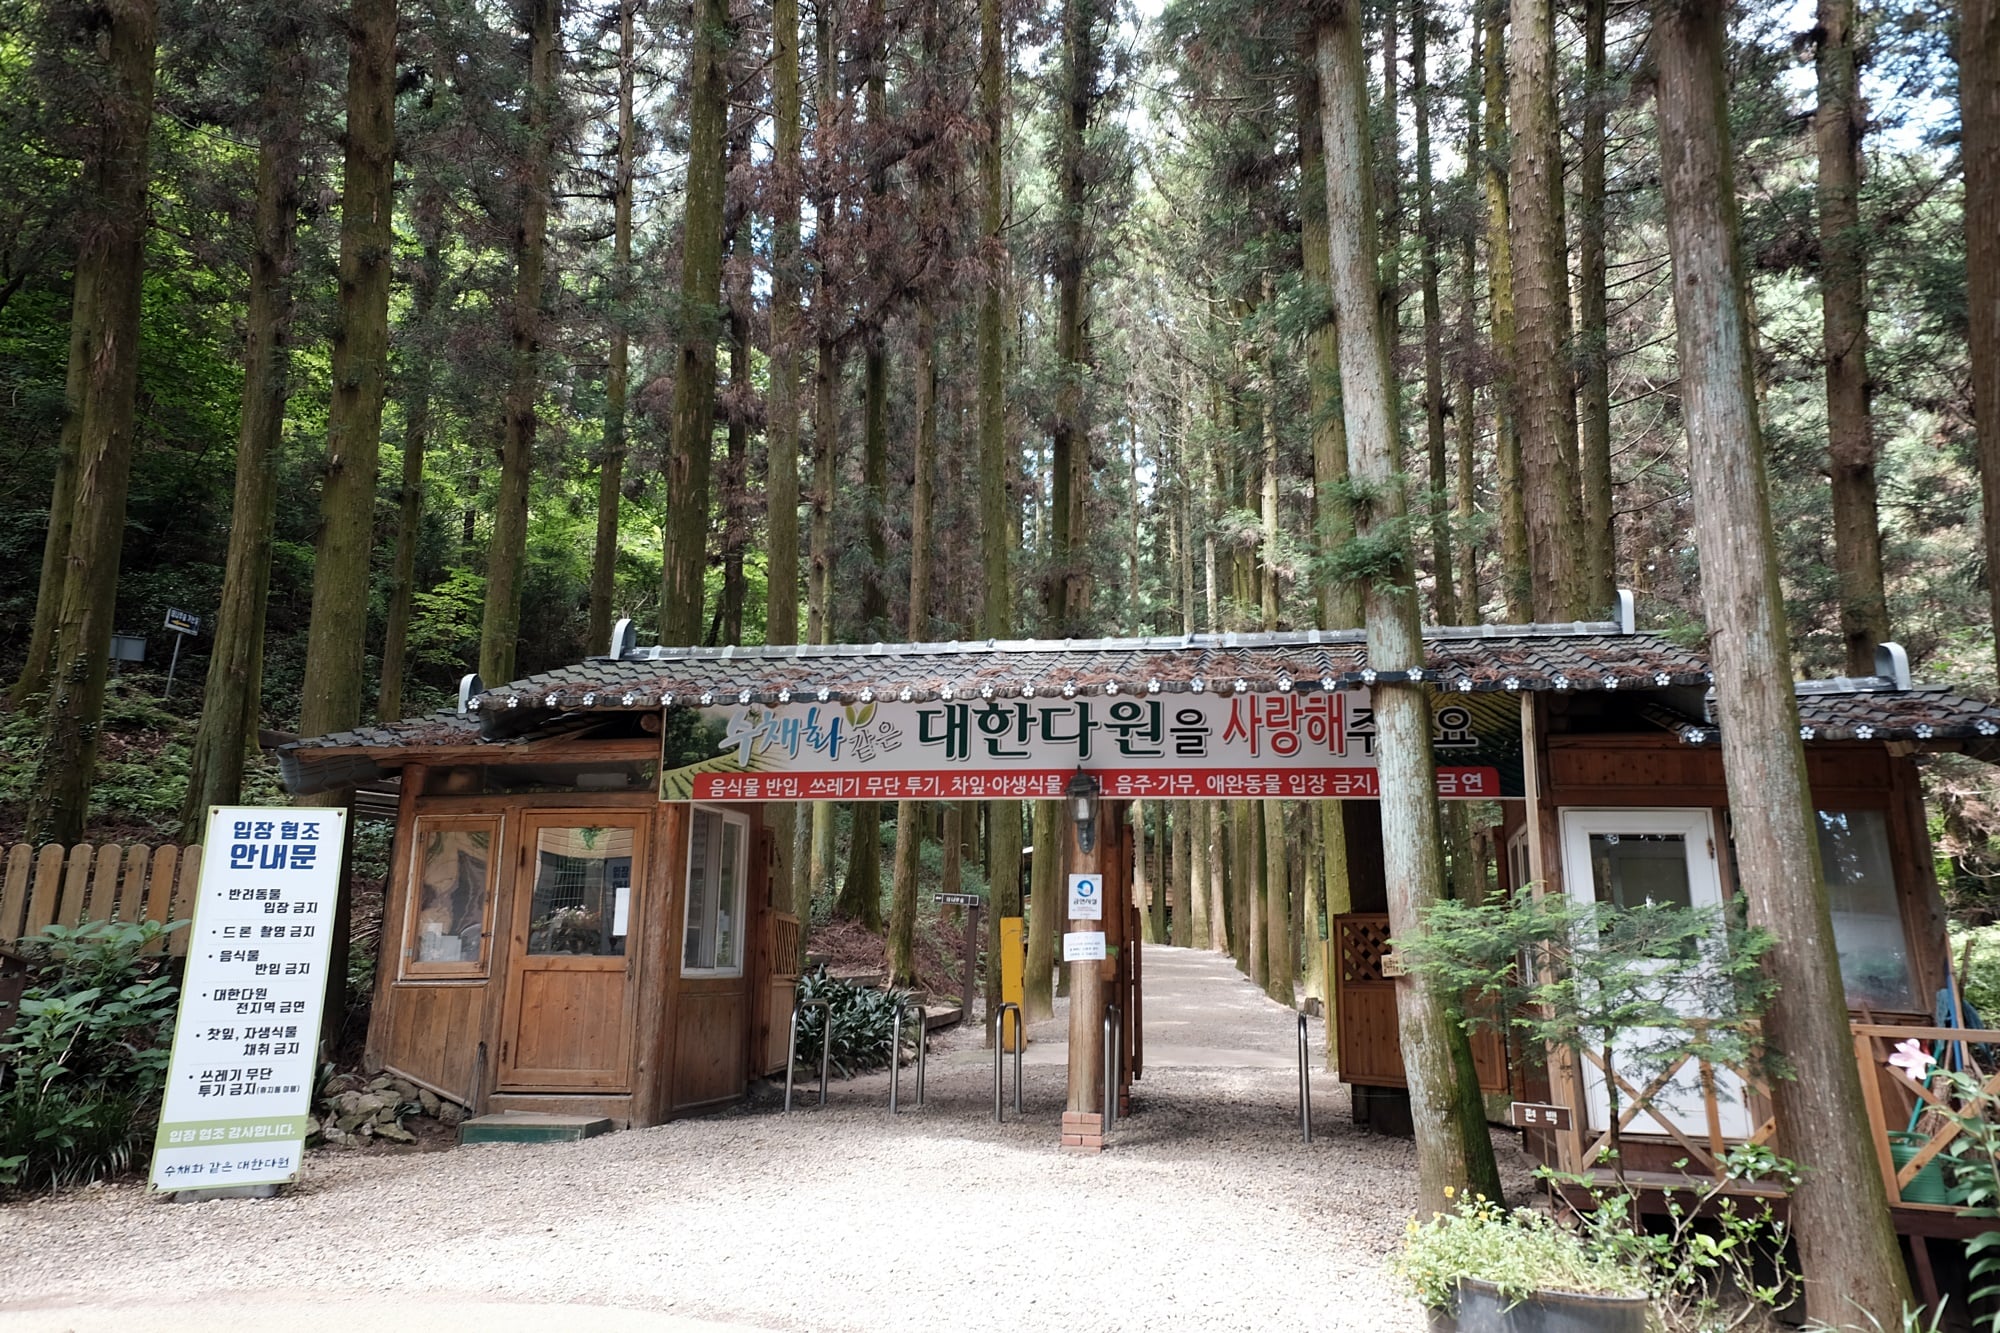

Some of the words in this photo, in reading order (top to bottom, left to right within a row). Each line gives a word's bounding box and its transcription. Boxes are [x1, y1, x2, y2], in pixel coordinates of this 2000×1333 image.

[718, 706, 847, 767] 수채화
[849, 720, 903, 761] 같은
[916, 700, 1210, 760] 대한다원을
[709, 778, 760, 797] 음식물
[765, 778, 803, 798] 반입,
[809, 777, 861, 796] 쓰레기
[865, 777, 901, 796] 무단
[905, 777, 945, 796] 투기,
[1206, 774, 1282, 793] 애완동물
[1289, 774, 1326, 793] 입장
[1332, 773, 1378, 794] 금지,
[233, 821, 275, 840] 입장
[281, 821, 320, 840] 협조
[230, 844, 316, 869] 안내문
[228, 888, 281, 901] 반려동물
[264, 902, 289, 913] 입장
[293, 902, 318, 914] 금지
[260, 926, 286, 938] 촬영
[290, 926, 315, 938] 금지
[219, 950, 260, 962] 음식물
[255, 963, 281, 976] 반입
[285, 963, 310, 975] 금지
[213, 988, 267, 1001] 대한다원
[236, 1001, 276, 1014] 전지역
[279, 1001, 305, 1013] 금연
[207, 1027, 239, 1041] 찻잎,
[243, 1026, 297, 1039] 자생식물
[243, 1043, 269, 1056] 채취
[274, 1042, 300, 1055] 금지
[200, 1069, 241, 1083] 쓰레기
[246, 1067, 273, 1081] 무단
[198, 1084, 225, 1098] 투기
[229, 1082, 257, 1096] 금지
[169, 1129, 196, 1143] 입장
[199, 1127, 225, 1141] 협조
[228, 1123, 295, 1139] 감사합니다.
[164, 1164, 205, 1177] 수채화
[209, 1161, 233, 1174] 같은
[237, 1157, 290, 1171] 대한다원
